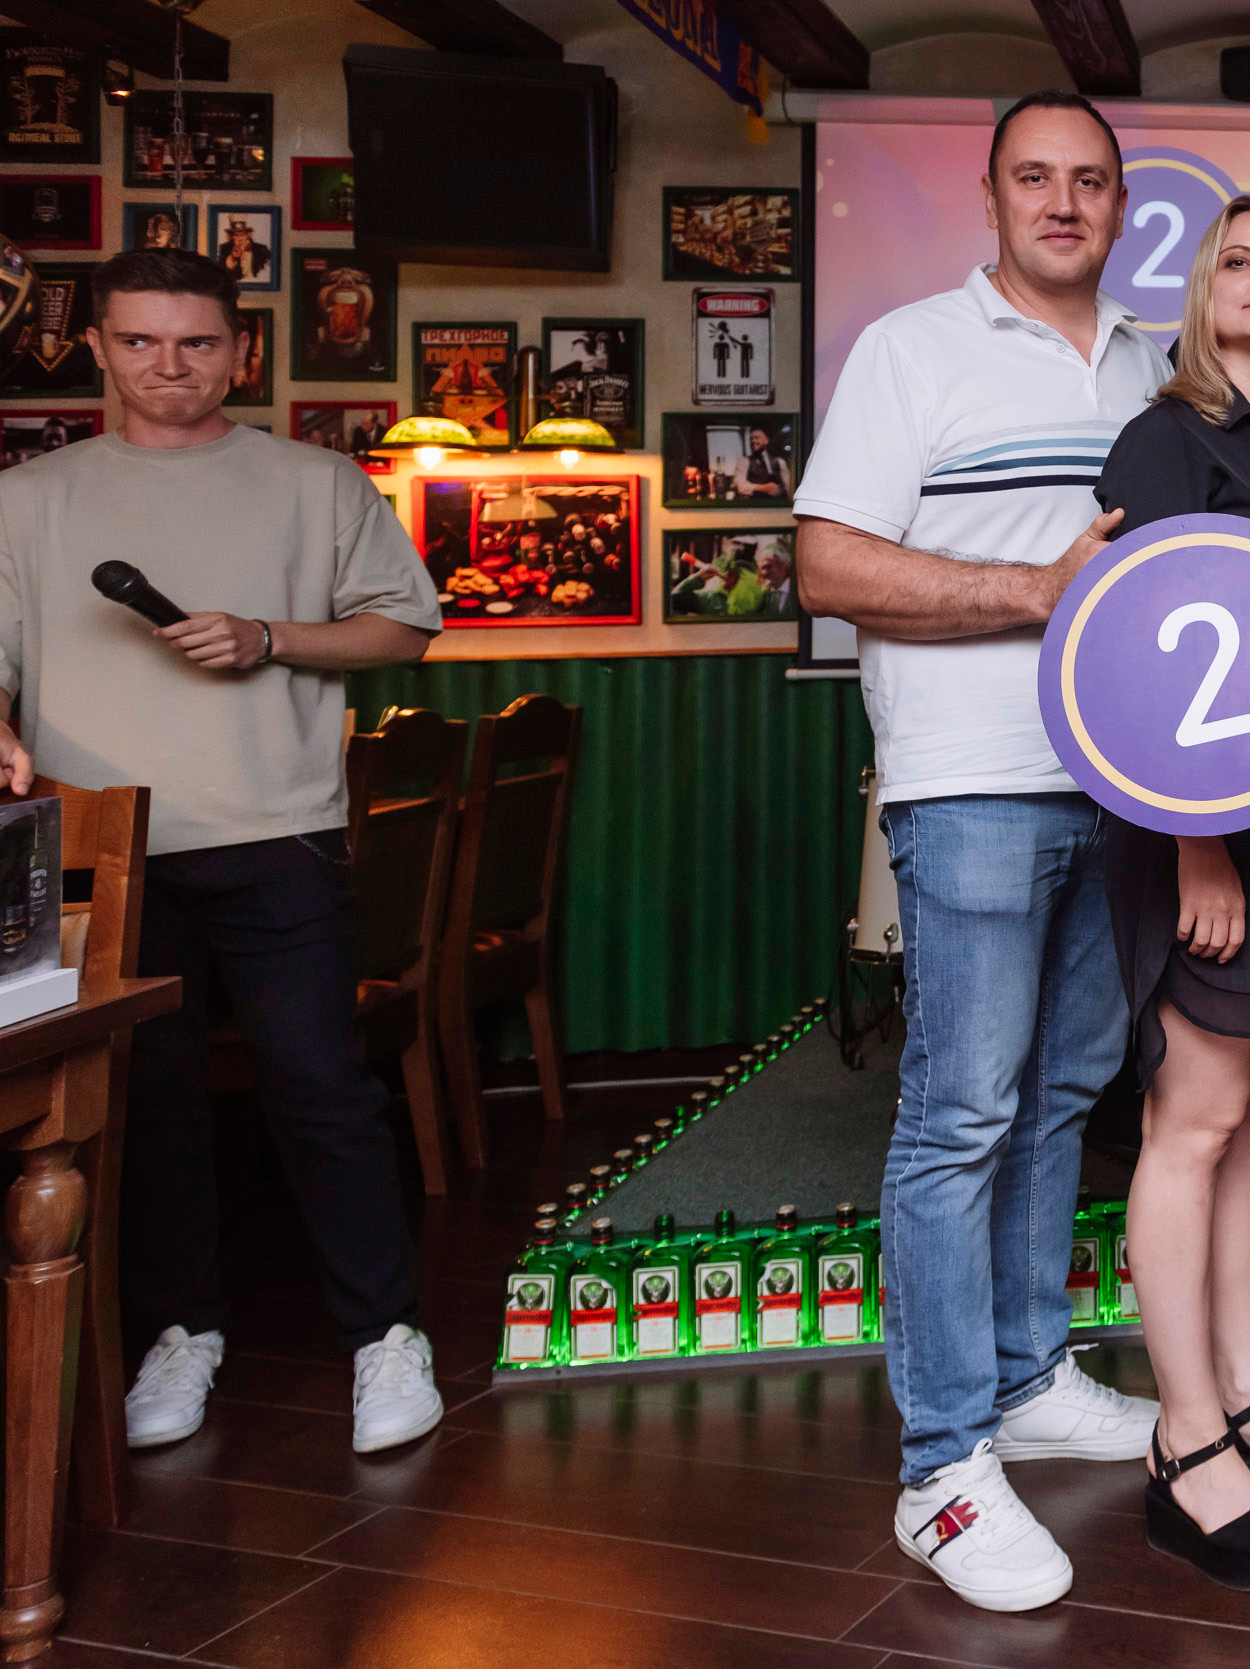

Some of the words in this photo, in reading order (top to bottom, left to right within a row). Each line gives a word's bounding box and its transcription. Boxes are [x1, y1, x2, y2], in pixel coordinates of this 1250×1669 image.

[1132, 201, 1185, 288] 2
[707, 299, 760, 312] WARNING
[422, 330, 507, 343] ТРЕХГОРНОЕ
[424, 347, 506, 363] ПИВО
[699, 383, 732, 395] NERVOUS
[734, 383, 767, 395] GUITARIST
